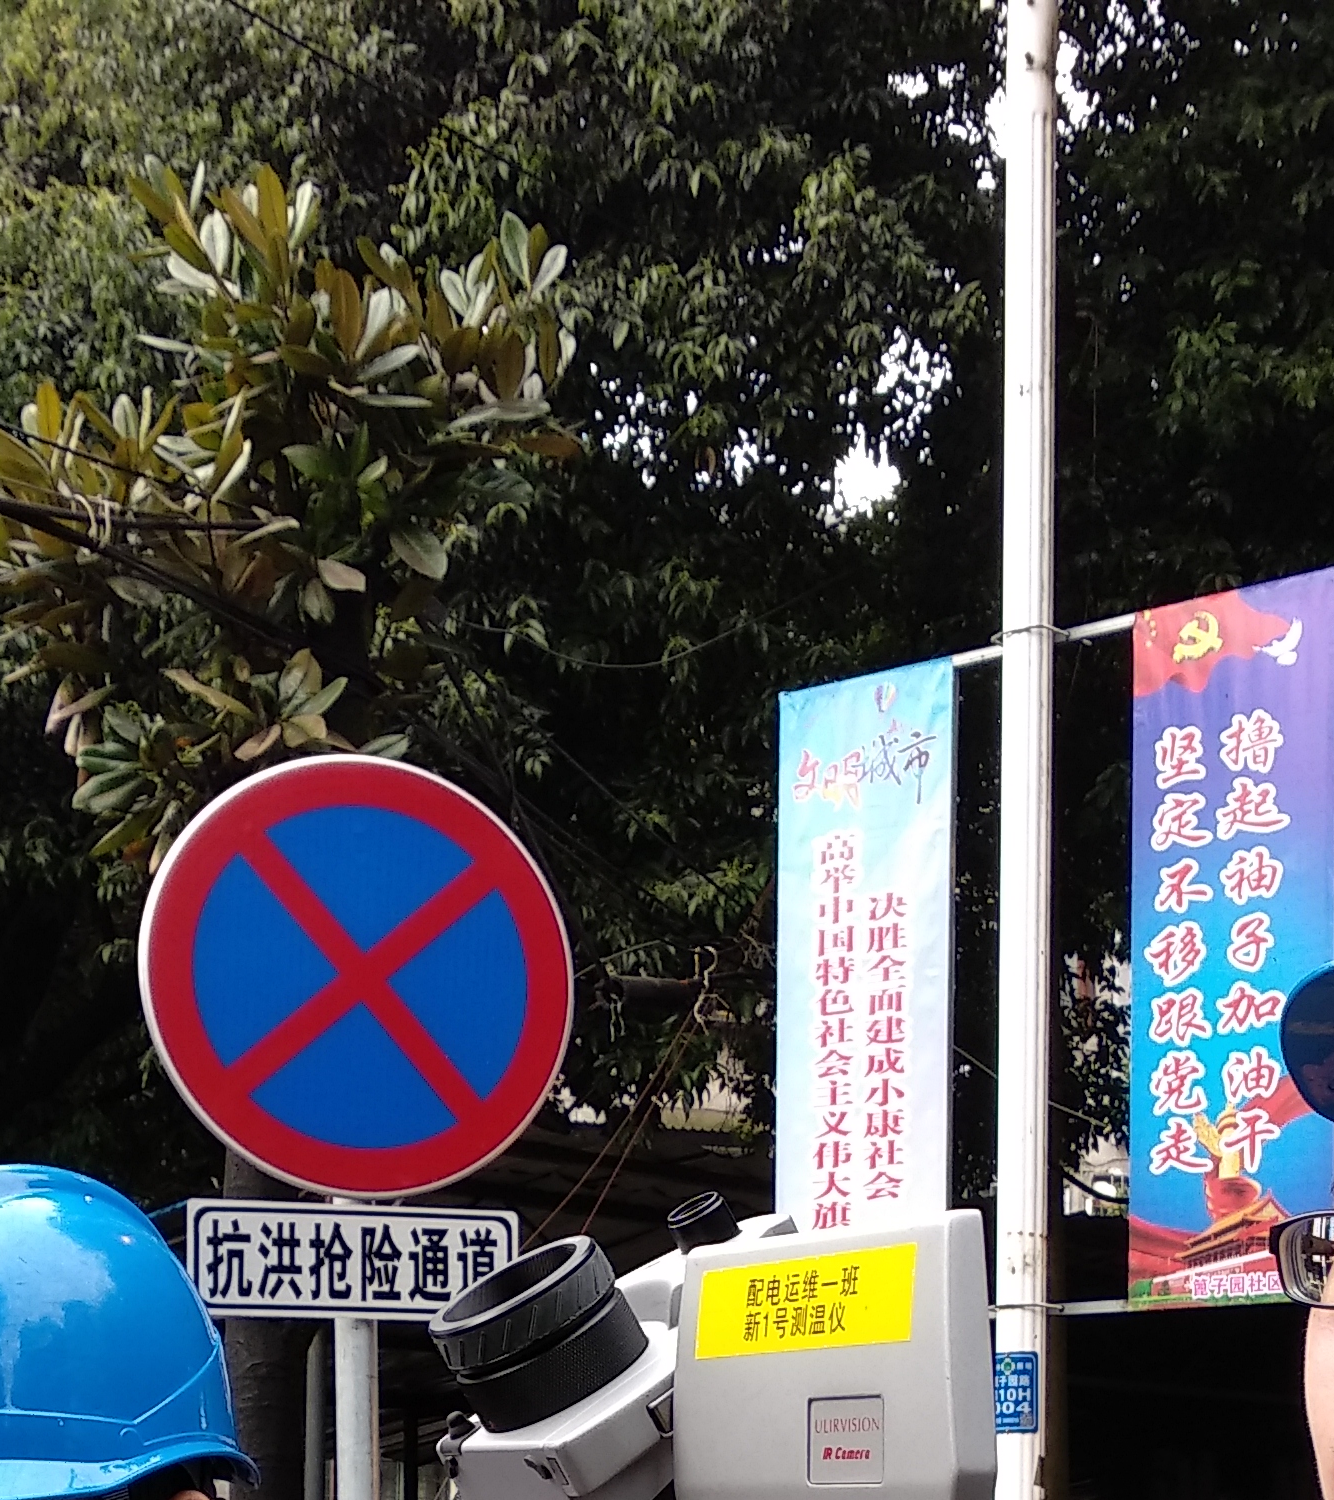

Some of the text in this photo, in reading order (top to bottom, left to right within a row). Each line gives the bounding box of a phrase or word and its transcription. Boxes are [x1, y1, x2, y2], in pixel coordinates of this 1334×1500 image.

[1147, 729, 1213, 1172] 坚定不移跟党走
[1219, 712, 1287, 1171] 撸起袖子加油干
[812, 834, 855, 1231] 高举中国特色社会主义伟大旗
[863, 892, 908, 1200] 决胜全面建成小康社会
[206, 1218, 498, 1302] 抗洪抢险通道
[746, 1265, 860, 1309] 配电运维一班
[743, 1301, 847, 1342] 新1号测温仪
[814, 1416, 880, 1434] ULIRVISION
[995, 1388, 1032, 1402] 10H
[822, 1446, 871, 1460] IR Camera
